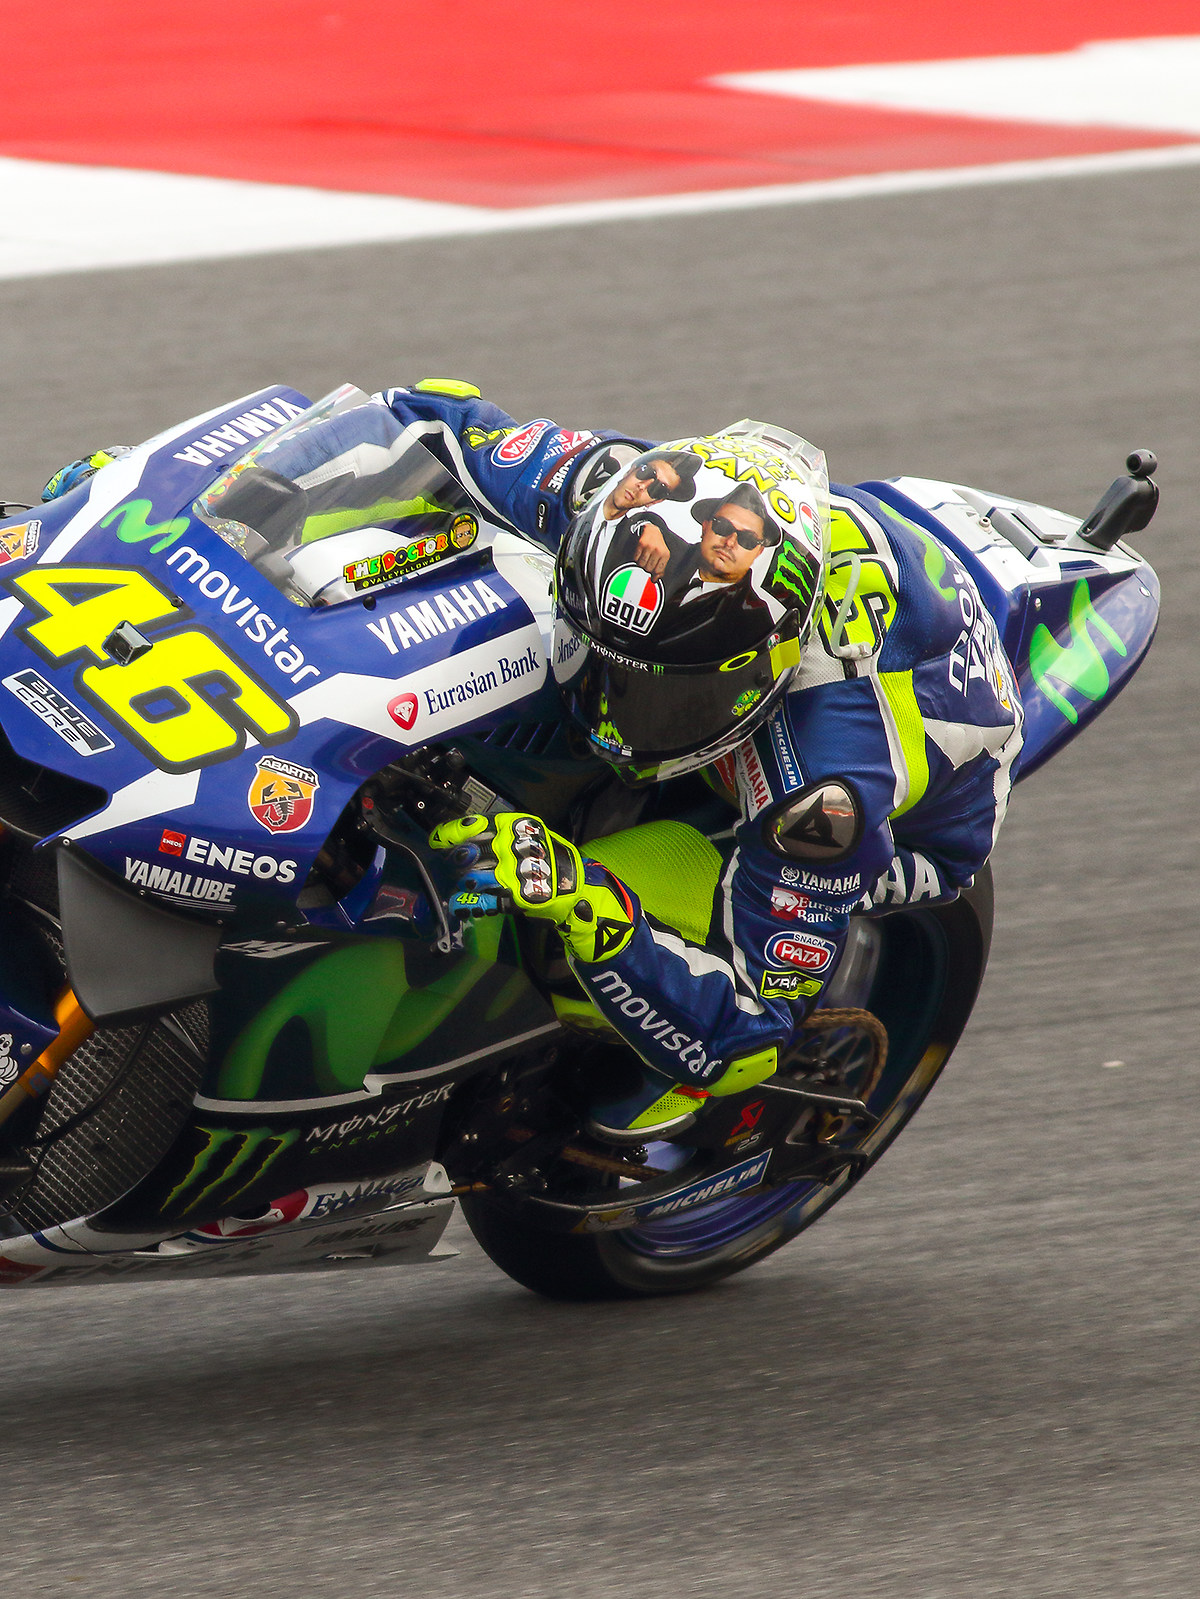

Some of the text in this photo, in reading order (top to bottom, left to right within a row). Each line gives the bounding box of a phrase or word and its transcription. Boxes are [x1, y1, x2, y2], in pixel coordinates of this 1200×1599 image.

[173, 397, 306, 466] YAMAHA
[503, 425, 542, 455] PATA
[344, 532, 449, 581] THE DOCTOR
[165, 546, 321, 685] movistar
[366, 579, 508, 656] YAMAHA
[606, 596, 650, 628] agv
[12, 568, 292, 763] 46
[423, 647, 540, 716] Eurasian Bank
[16, 687, 81, 742] CORE
[30, 680, 98, 738] BLUE
[262, 758, 315, 783] ABARTH
[774, 720, 798, 787] MICHELIN
[162, 837, 183, 849] ENEOS
[185, 836, 298, 884] ENEOS
[125, 856, 236, 903] YAMALUBE
[456, 892, 480, 905] 46
[801, 870, 861, 892] YAMAHA
[797, 908, 834, 924] Bank
[780, 943, 822, 966] PATA
[794, 933, 825, 948] SNACK
[591, 970, 723, 1078] movistar
[309, 1118, 415, 1155] ENERGY
[647, 1161, 764, 1217] MICHELIN
